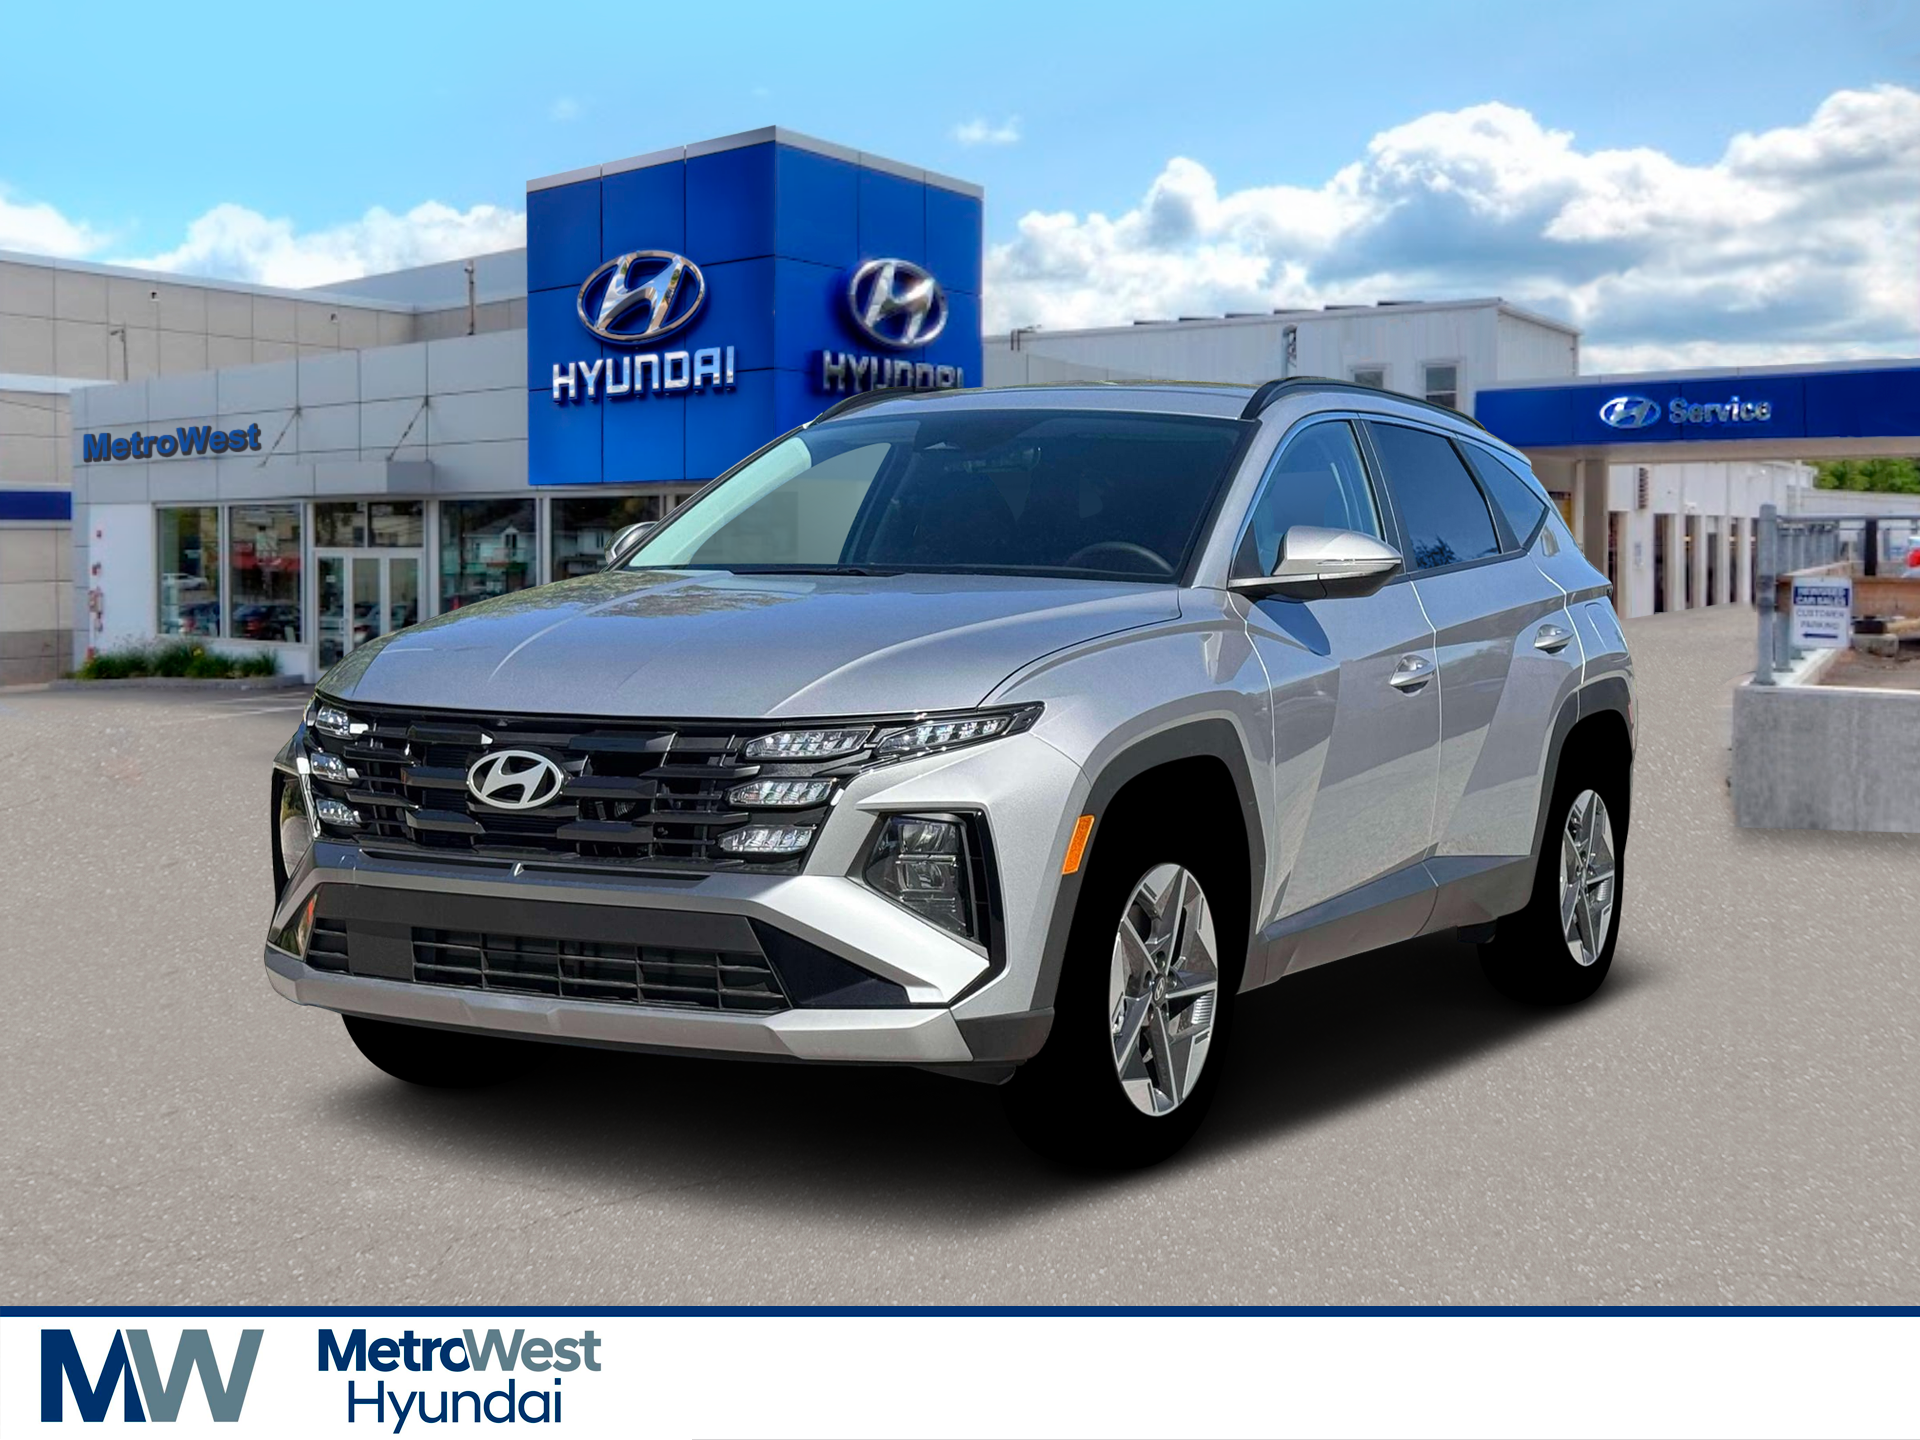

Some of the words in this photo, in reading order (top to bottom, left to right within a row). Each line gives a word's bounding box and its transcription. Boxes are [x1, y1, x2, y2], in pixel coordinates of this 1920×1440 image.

[553, 346, 734, 399] HYUNDAI
[1669, 396, 1771, 423] Service
[83, 423, 261, 462] MetroWest
[1796, 609, 1844, 618] CUSTOMER
[1801, 620, 1839, 630] PARKING
